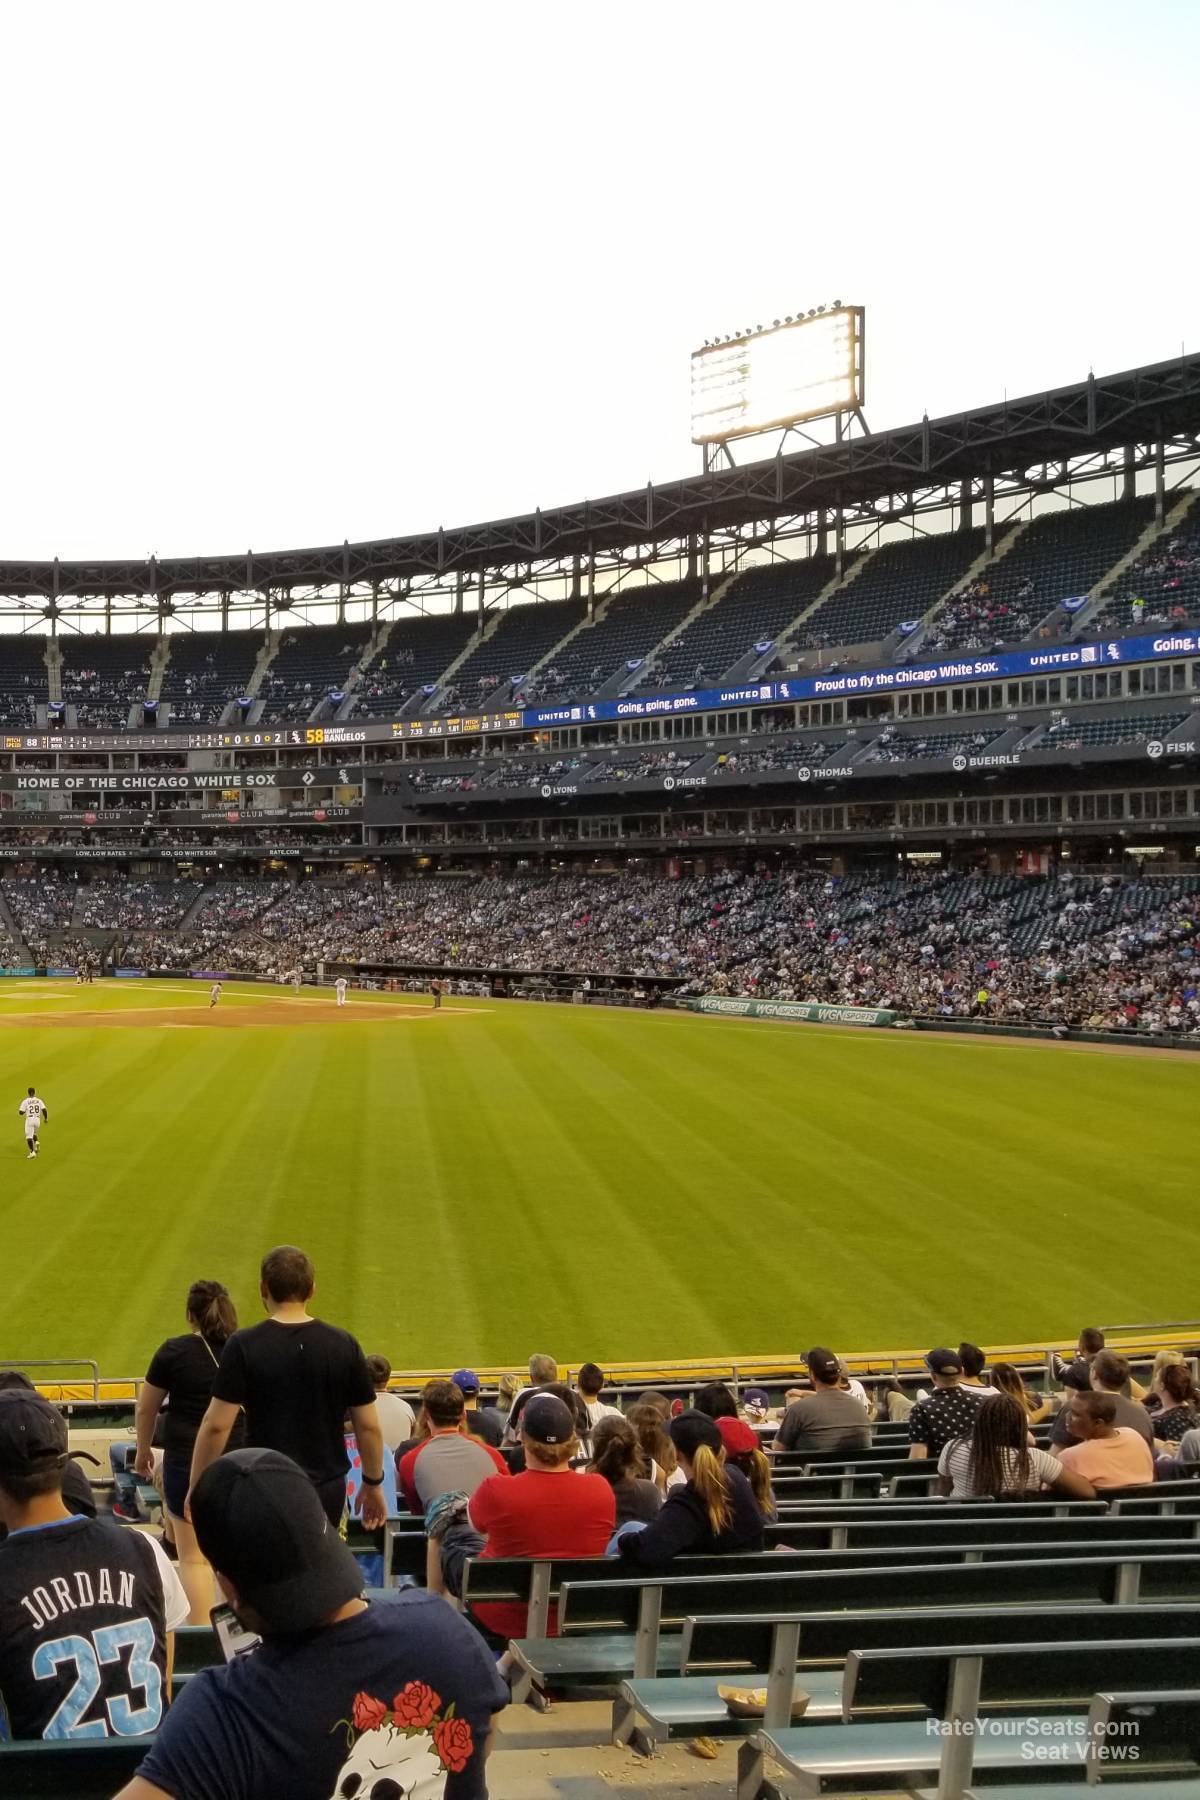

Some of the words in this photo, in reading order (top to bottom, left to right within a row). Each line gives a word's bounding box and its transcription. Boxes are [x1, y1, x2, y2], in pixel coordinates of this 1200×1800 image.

[1153, 637, 1195, 652] Going,
[1030, 652, 1079, 665] UNITED
[815, 678, 846, 691] Proud
[847, 678, 858, 688] to
[860, 675, 874, 688] fly
[876, 674, 894, 685] the
[896, 669, 937, 683] Chicago
[940, 664, 973, 677] White
[975, 662, 999, 674] Sox.
[720, 690, 759, 701] UNITED
[617, 703, 644, 713] Going,
[646, 699, 672, 710] going,
[674, 697, 698, 708] gone.
[538, 711, 570, 721] UNITED
[234, 735, 241, 744] 0
[254, 734, 261, 743] 0
[274, 733, 281, 743] 2
[306, 729, 324, 743] 58
[324, 732, 366, 743] BANUELOS
[26, 738, 38, 747] 88
[1166, 742, 1196, 753] FISK
[969, 755, 1020, 766] BUEHRLE
[813, 767, 853, 777] THOMAS
[17, 777, 60, 788] HOME
[64, 777, 85, 788] OF
[89, 777, 118, 788] THE
[122, 776, 189, 788] CHICAGO
[193, 775, 242, 786] WHITE
[246, 774, 276, 786] SOX
[676, 777, 707, 786] PIERCE
[553, 786, 577, 794] LYONS
[327, 808, 350, 816] CLUB
[700, 999, 722, 1010] WGN
[756, 1003, 781, 1015] WGN
[780, 1007, 810, 1017] SPORTS
[818, 1008, 844, 1020] WGN
[844, 1011, 877, 1023] SPORTS
[29, 1105, 40, 1114] 28
[20, 1568, 136, 1630] JORDAN
[32, 1617, 163, 1740] 23
